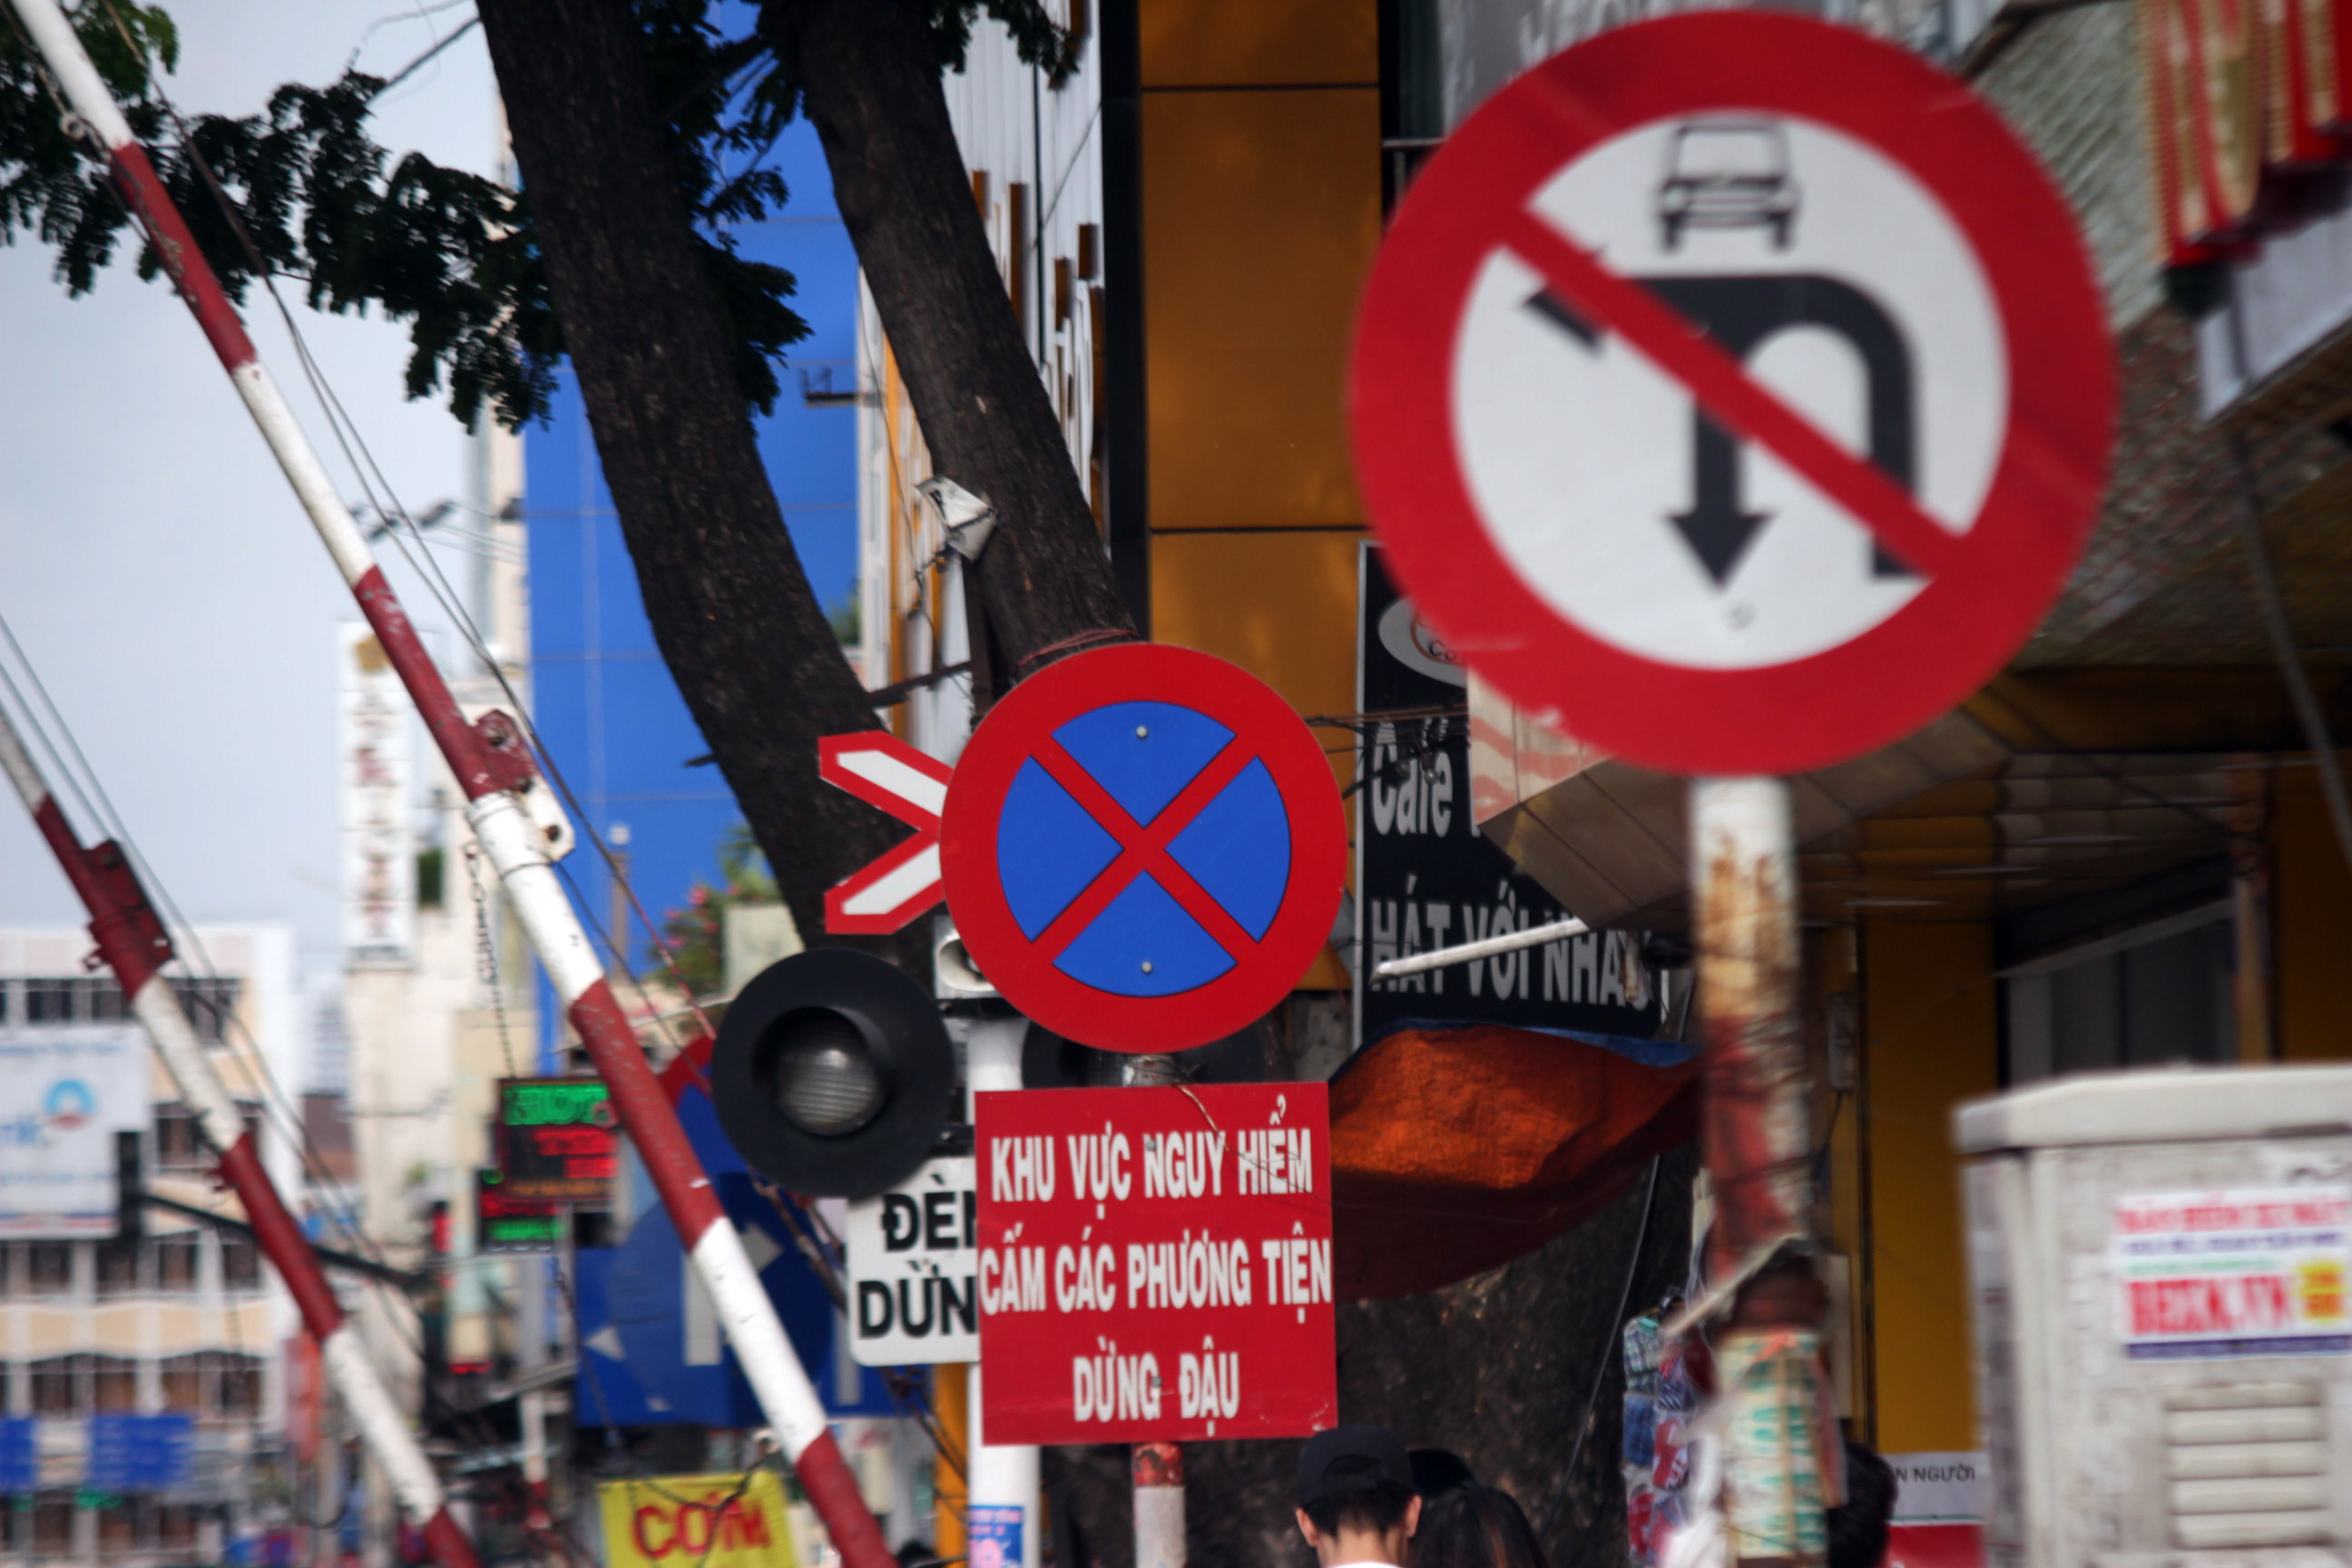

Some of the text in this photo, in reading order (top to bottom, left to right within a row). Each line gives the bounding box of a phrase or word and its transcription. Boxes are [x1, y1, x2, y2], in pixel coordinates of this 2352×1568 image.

[1370, 874, 1451, 995] HÁT
[1463, 880, 1530, 1000] VỚI
[991, 1093, 1313, 1220] KHU VỰC NGUY HIỂM
[979, 1221, 1332, 1324] CẤM CÁC PHƯƠNG TIỆN
[1073, 1334, 1240, 1437] DỪNG ĐẬU
